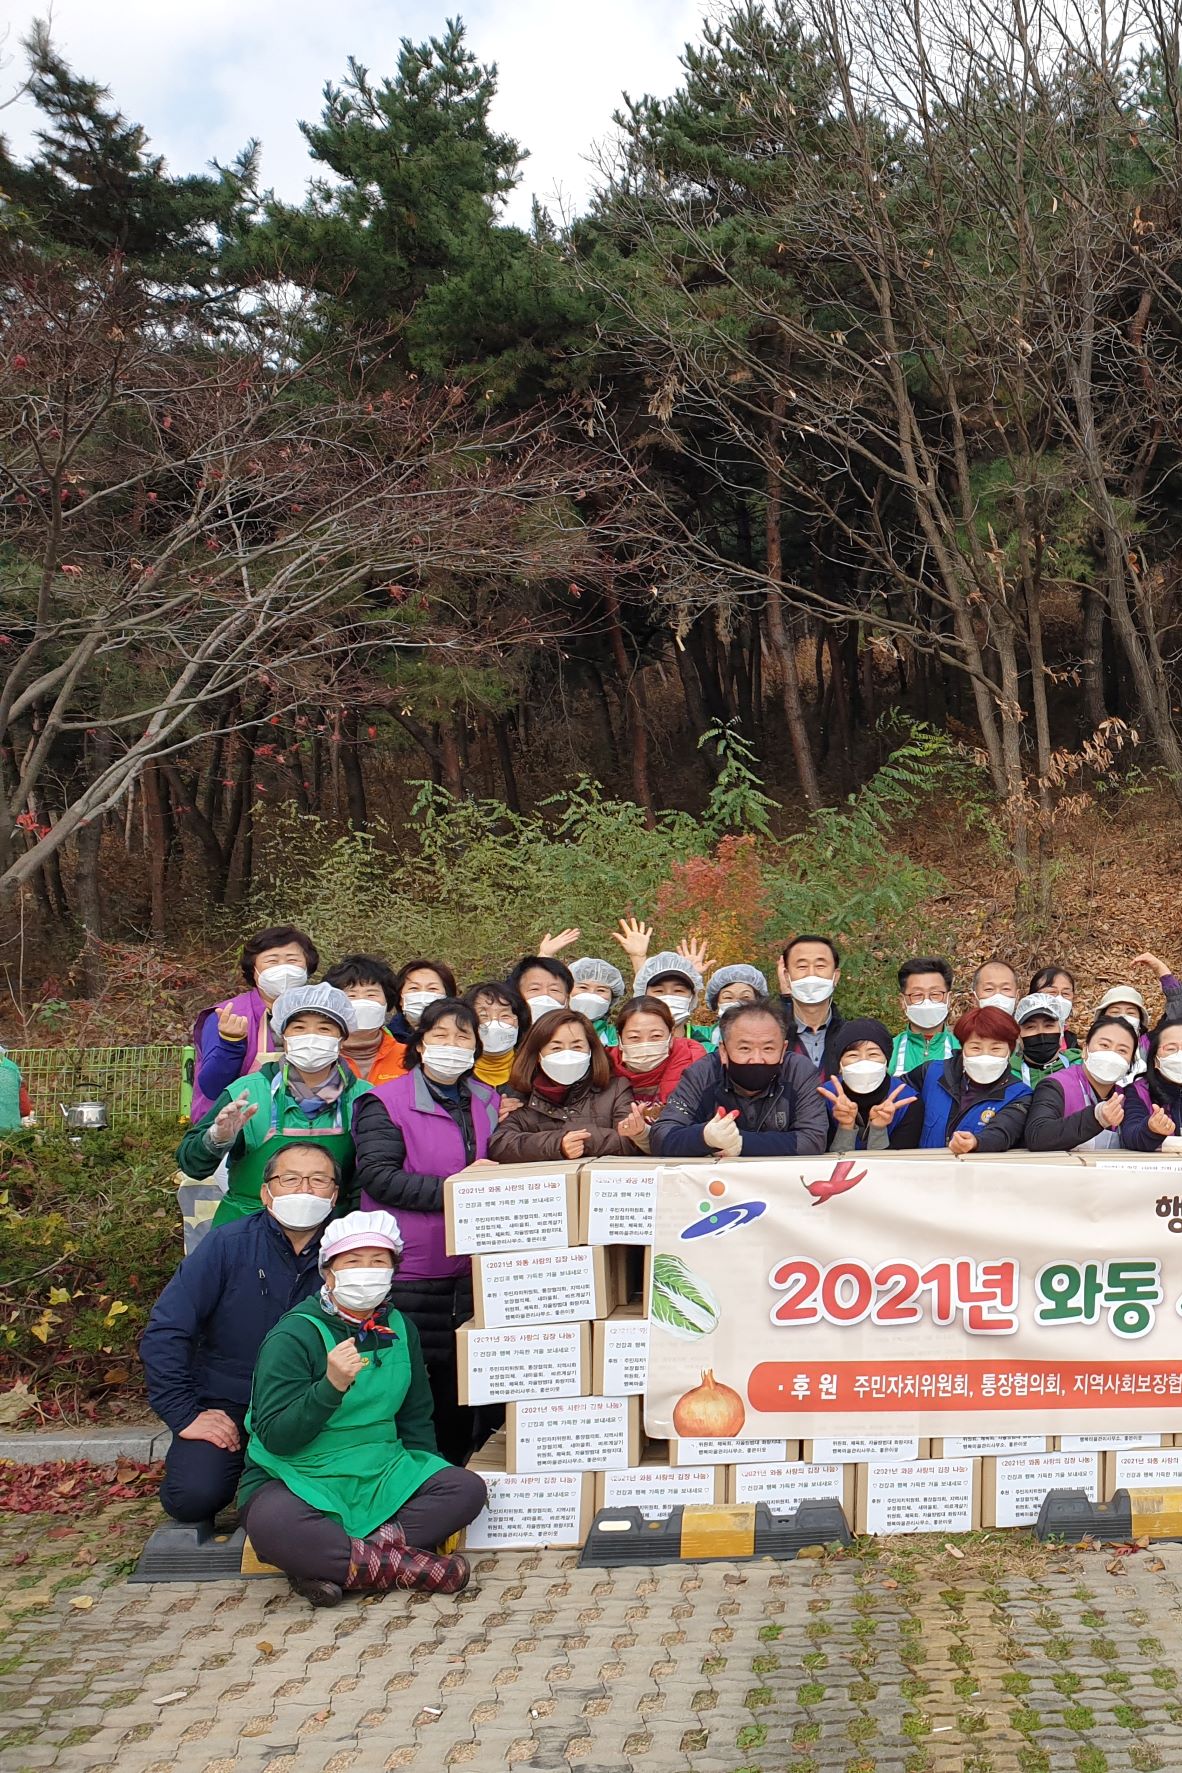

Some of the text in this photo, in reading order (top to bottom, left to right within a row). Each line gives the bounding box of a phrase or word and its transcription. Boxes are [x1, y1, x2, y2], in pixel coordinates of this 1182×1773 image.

[774, 1261, 1015, 1331] 2021년
[1038, 1262, 1159, 1334] 와동
[852, 1373, 974, 1398] 주민자치위원회,
[980, 1372, 1067, 1397] 통장협의회,
